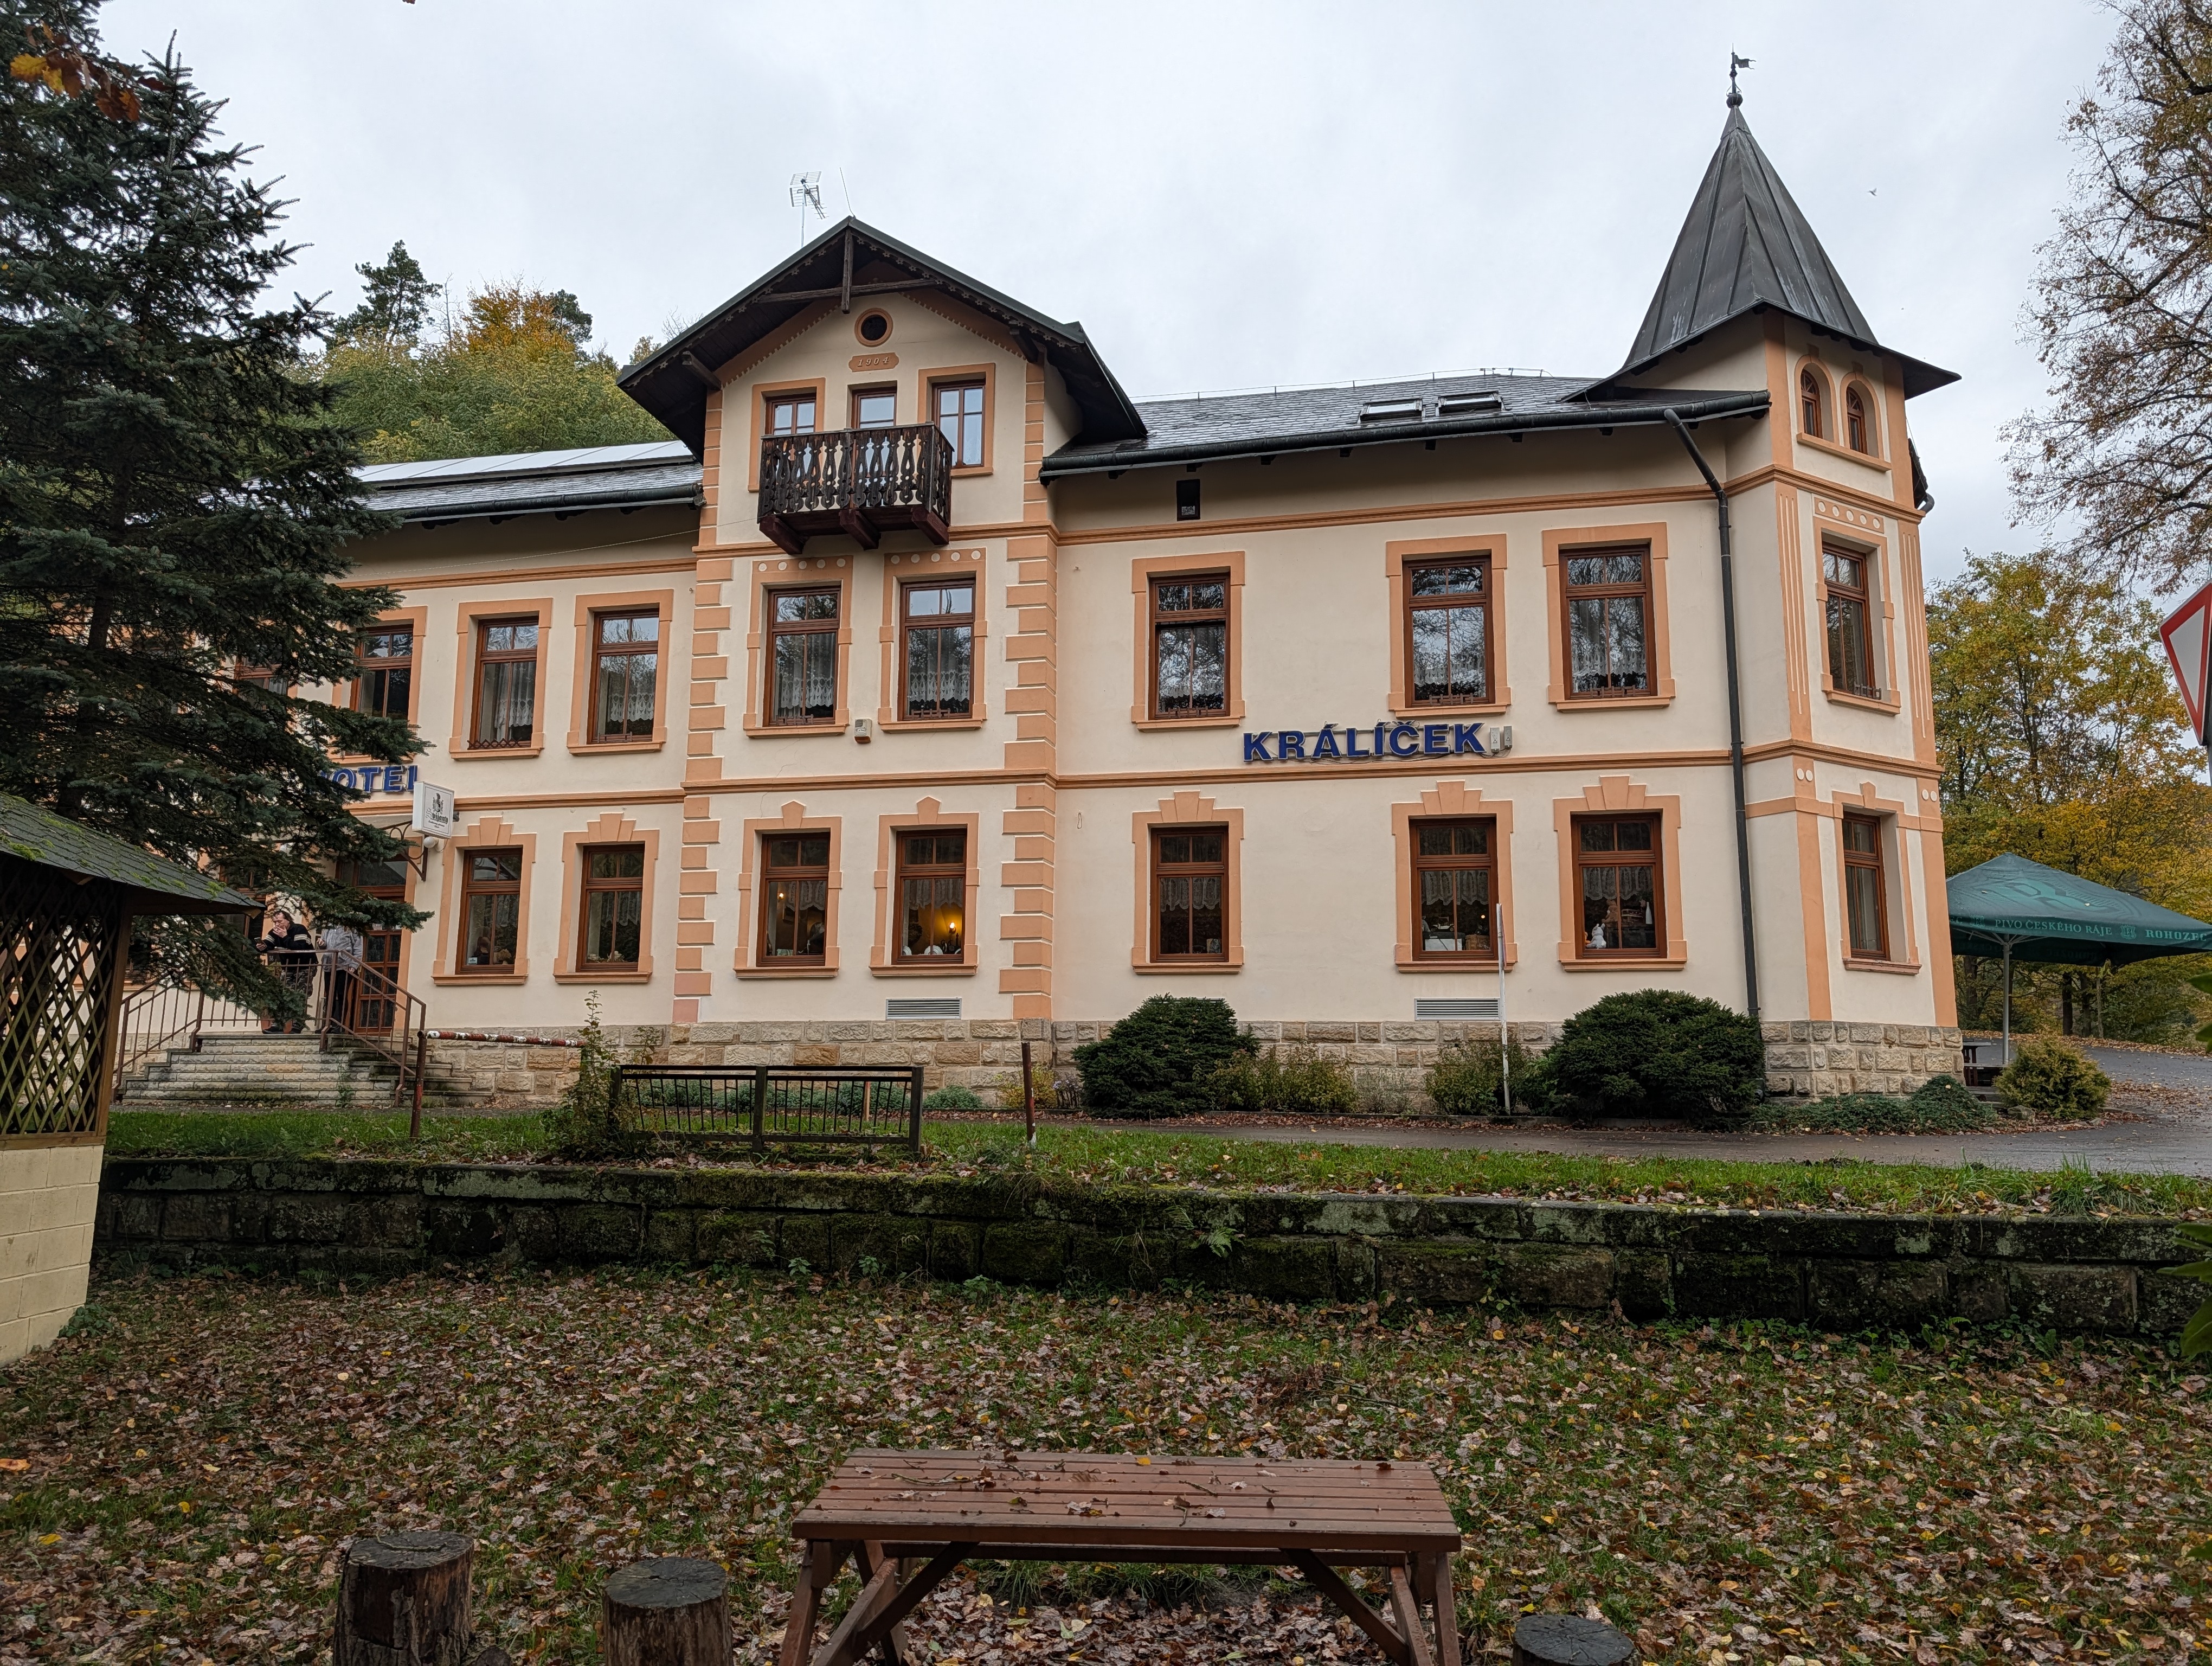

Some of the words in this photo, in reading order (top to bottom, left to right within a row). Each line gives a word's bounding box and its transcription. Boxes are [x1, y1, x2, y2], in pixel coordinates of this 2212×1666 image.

[857, 356, 890, 367] 1904
[1243, 721, 1487, 762] KRÁLÍČEK
[319, 765, 418, 793] OTEL
[1995, 919, 2023, 929] PIVO
[2025, 920, 2082, 933] ČESKÉHO
[2085, 925, 2112, 937] RÁJE
[2145, 930, 2207, 941] ROHOZEC
